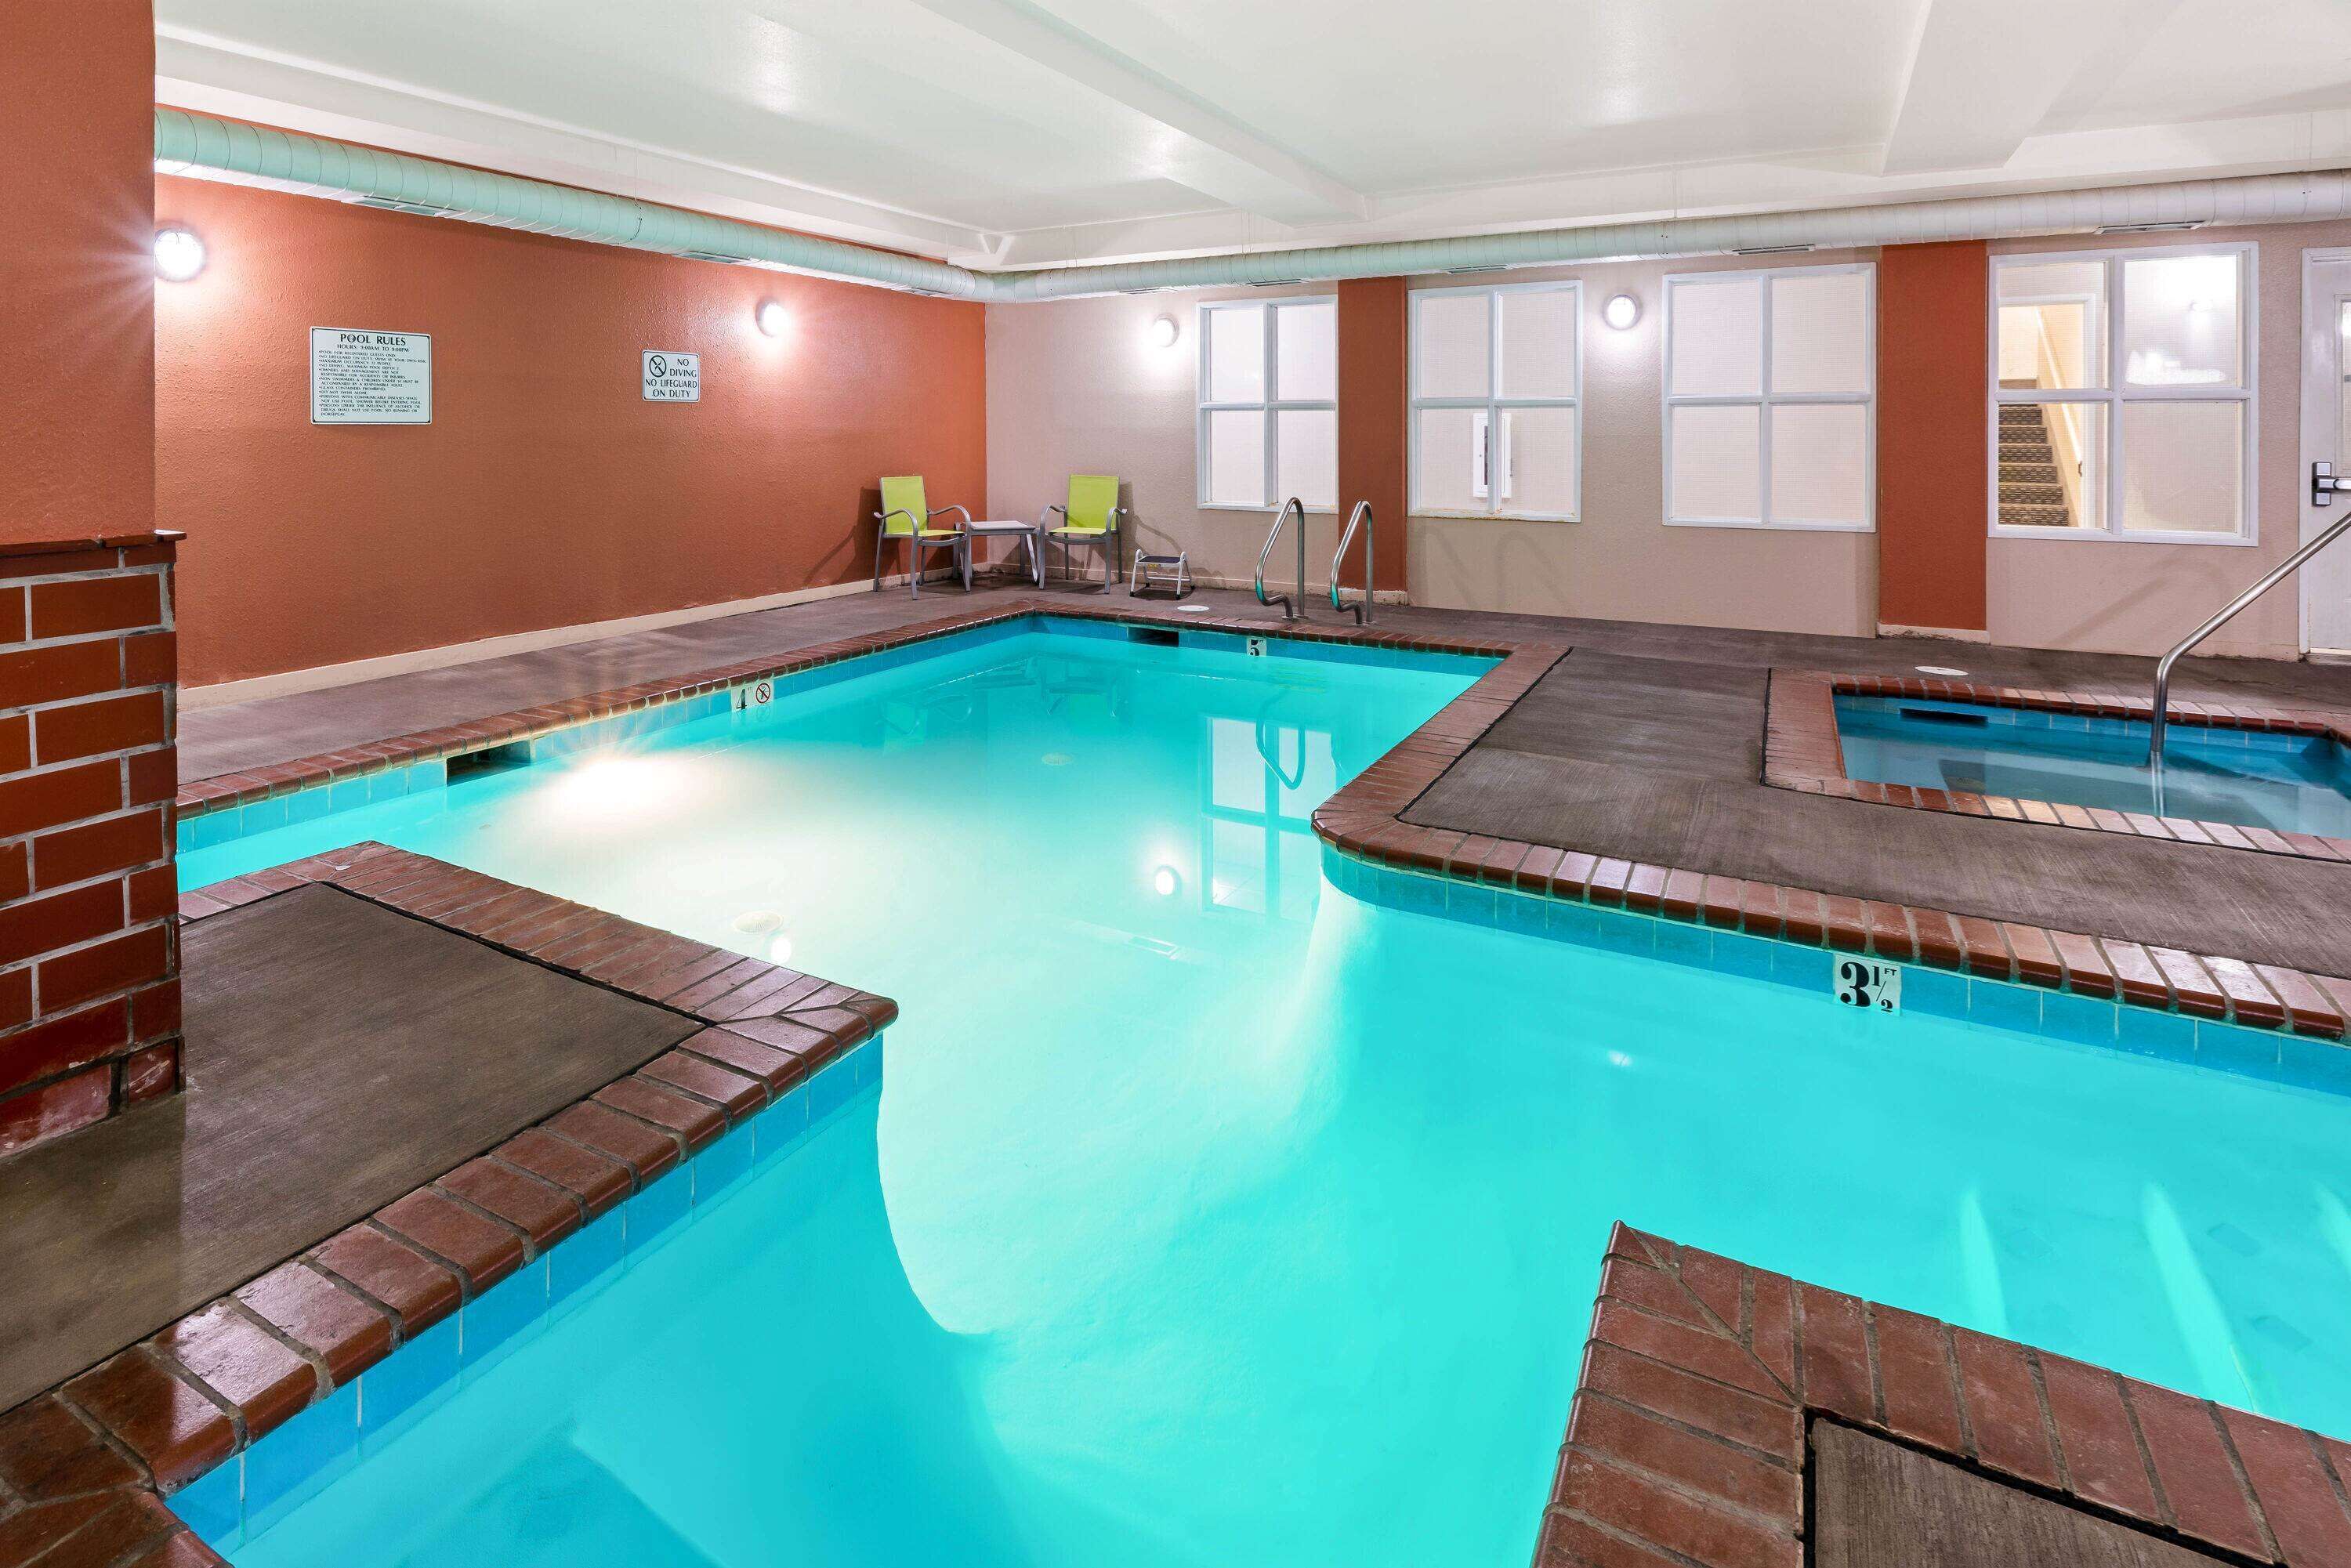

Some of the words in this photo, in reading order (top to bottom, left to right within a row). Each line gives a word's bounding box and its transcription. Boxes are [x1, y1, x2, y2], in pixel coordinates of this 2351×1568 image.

[340, 334, 371, 343] POOL
[376, 336, 406, 346] RULES
[677, 358, 690, 367] NO
[669, 368, 697, 378] DIVING
[660, 379, 697, 388] LIFEGUARD
[652, 389, 665, 397] ON
[1250, 639, 1259, 656] 5
[736, 688, 747, 710] 4
[1840, 961, 1871, 1008] 3
[1884, 968, 1897, 976] FT
